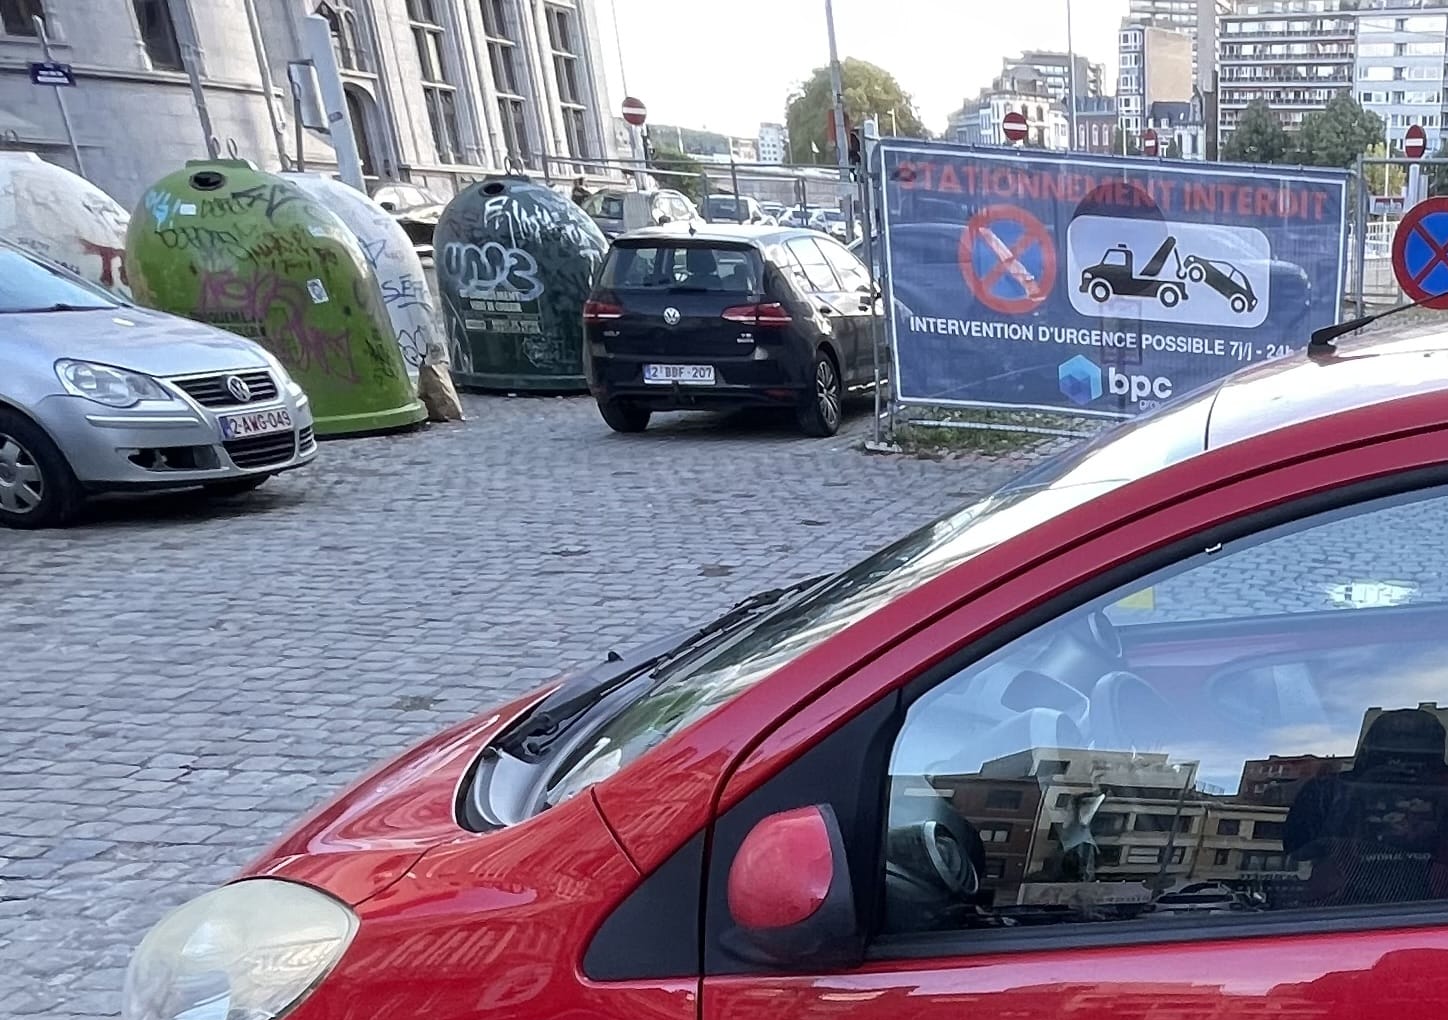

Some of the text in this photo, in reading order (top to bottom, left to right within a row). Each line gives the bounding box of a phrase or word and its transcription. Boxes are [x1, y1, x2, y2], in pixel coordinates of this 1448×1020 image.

[897, 160, 1327, 221] STATIONNEMENT INTERDIT
[910, 316, 1033, 341] INTERVENTION
[1039, 327, 1137, 348] D'URGENCE
[1142, 333, 1225, 355] POSSIBLE
[1229, 341, 1252, 361] 7j/j
[1108, 366, 1172, 402] bpc
[230, 411, 291, 434] 2-AWG-049
